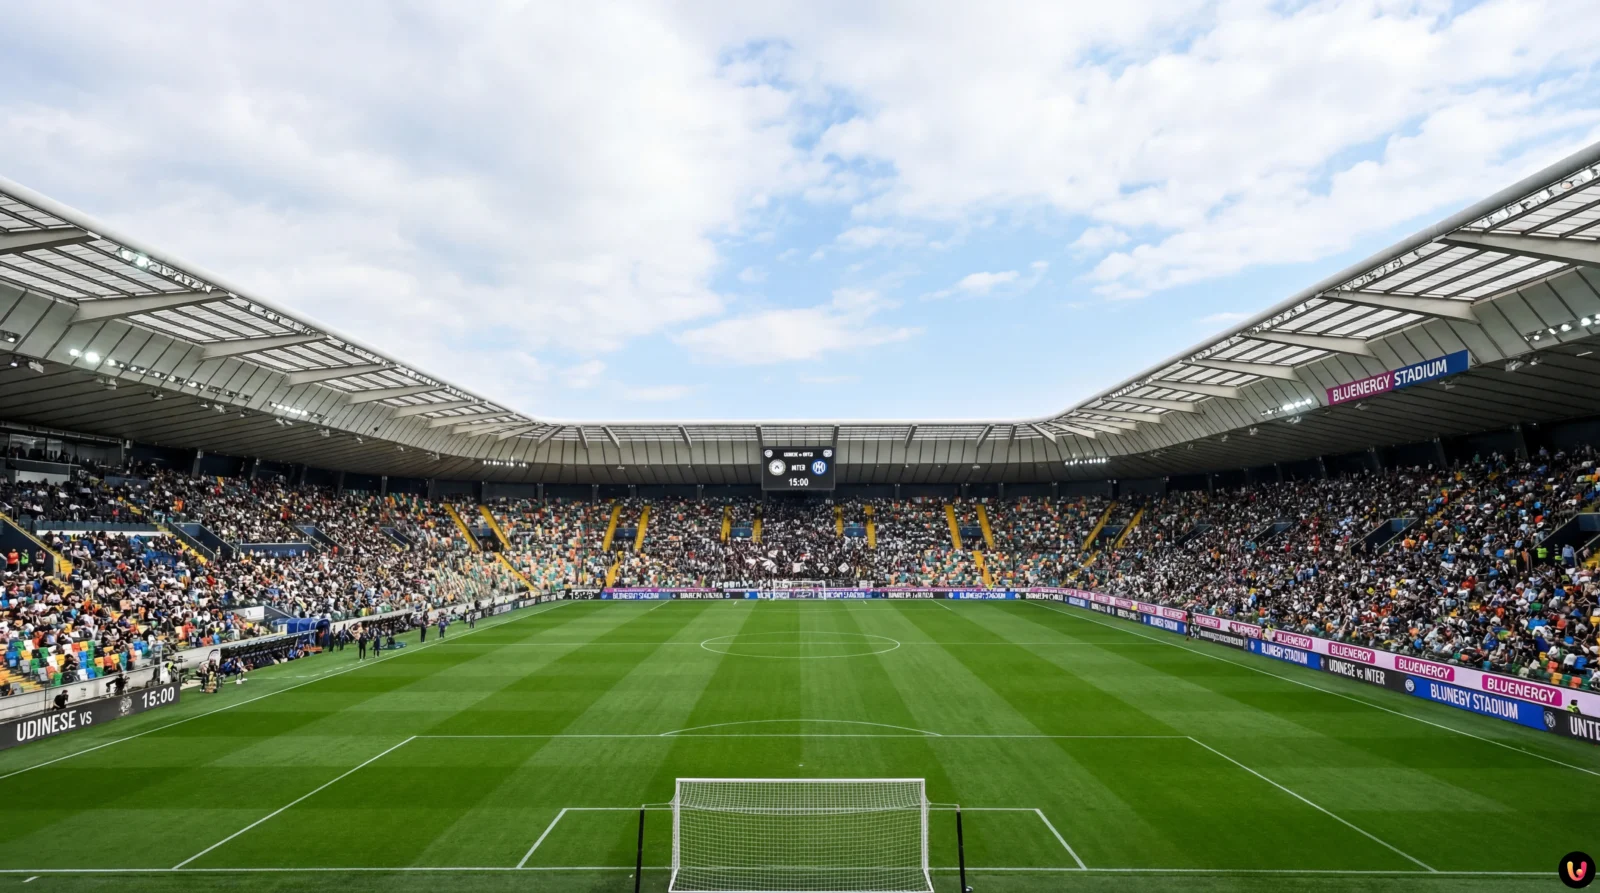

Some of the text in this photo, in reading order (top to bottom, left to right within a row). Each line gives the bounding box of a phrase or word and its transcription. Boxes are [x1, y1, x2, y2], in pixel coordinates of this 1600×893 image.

[1332, 358, 1448, 402] BLUENERGY STADIUM
[788, 477, 809, 487] 15:00
[1331, 644, 1372, 662] BLUENERGY
[1328, 658, 1356, 678] UDINESE
[1364, 668, 1386, 685] INTER
[1398, 659, 1451, 679] BLUENERGY
[141, 686, 175, 709] 15:00
[1430, 683, 1519, 720] BLUNEGY STADIUM
[1487, 677, 1556, 703] BLUENERGY
[16, 710, 77, 742] UDINESE
